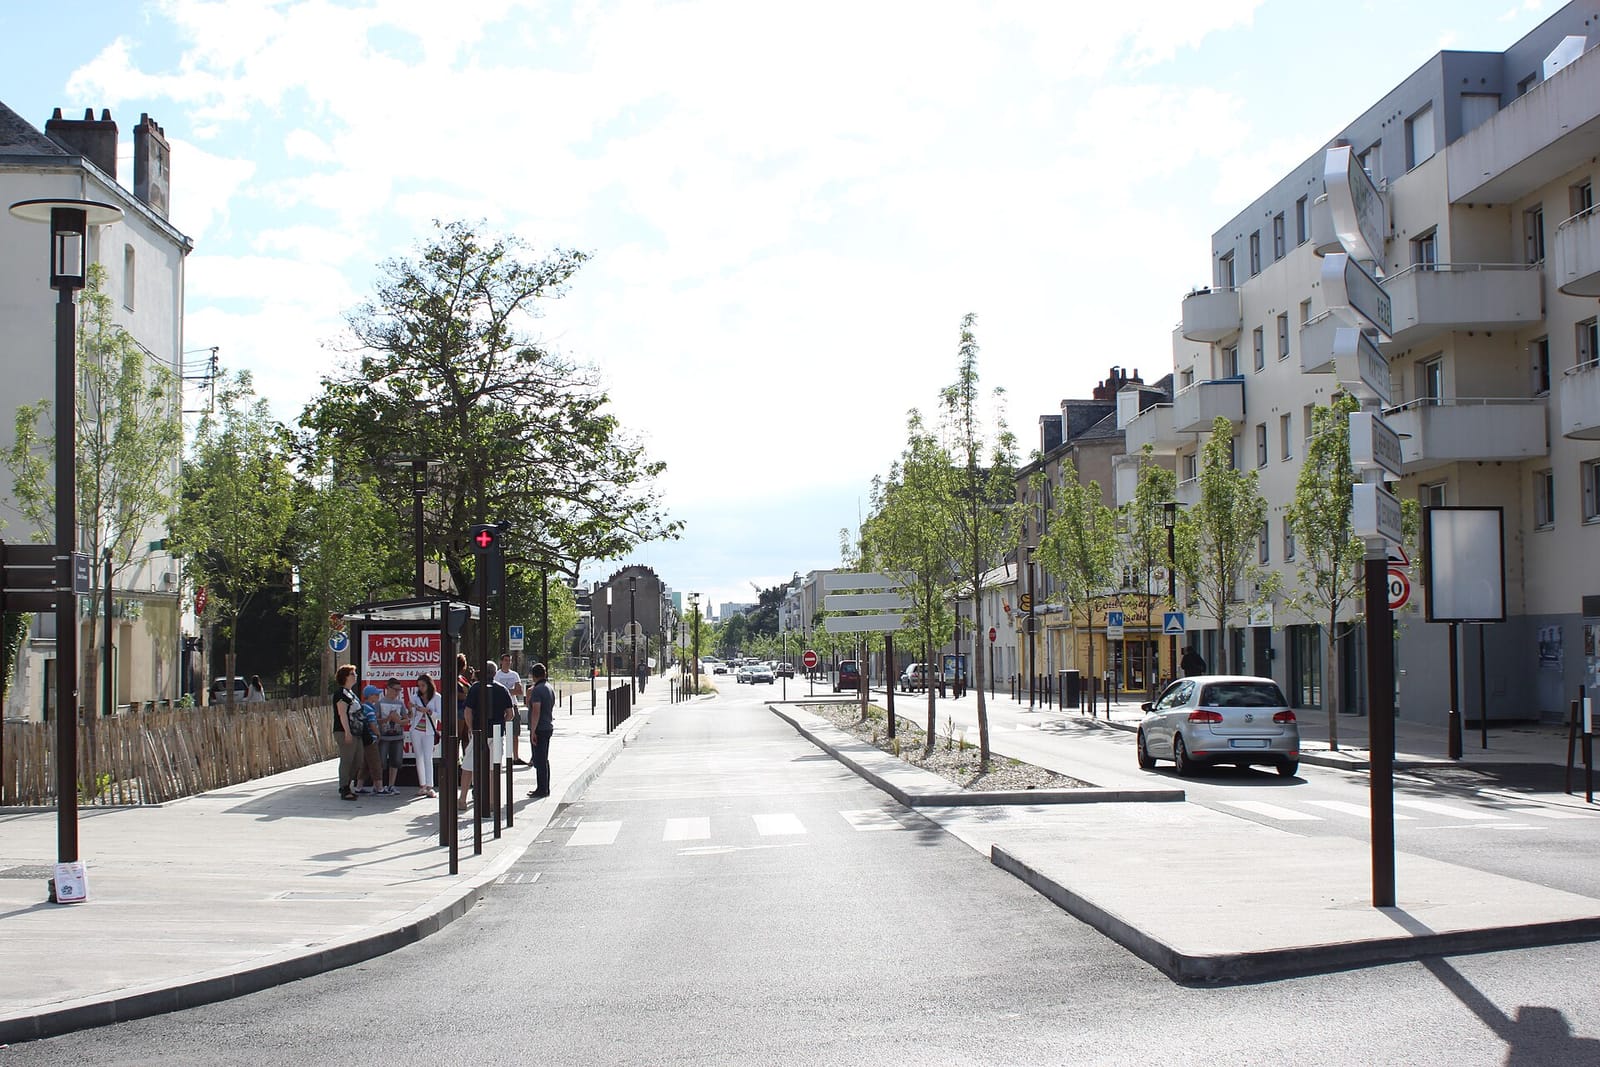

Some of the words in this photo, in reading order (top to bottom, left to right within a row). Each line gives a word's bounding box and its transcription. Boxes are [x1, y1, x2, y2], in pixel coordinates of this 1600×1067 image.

[383, 637, 429, 648] FORUM
[369, 651, 396, 662] AUX
[398, 651, 440, 662] TISSUS
